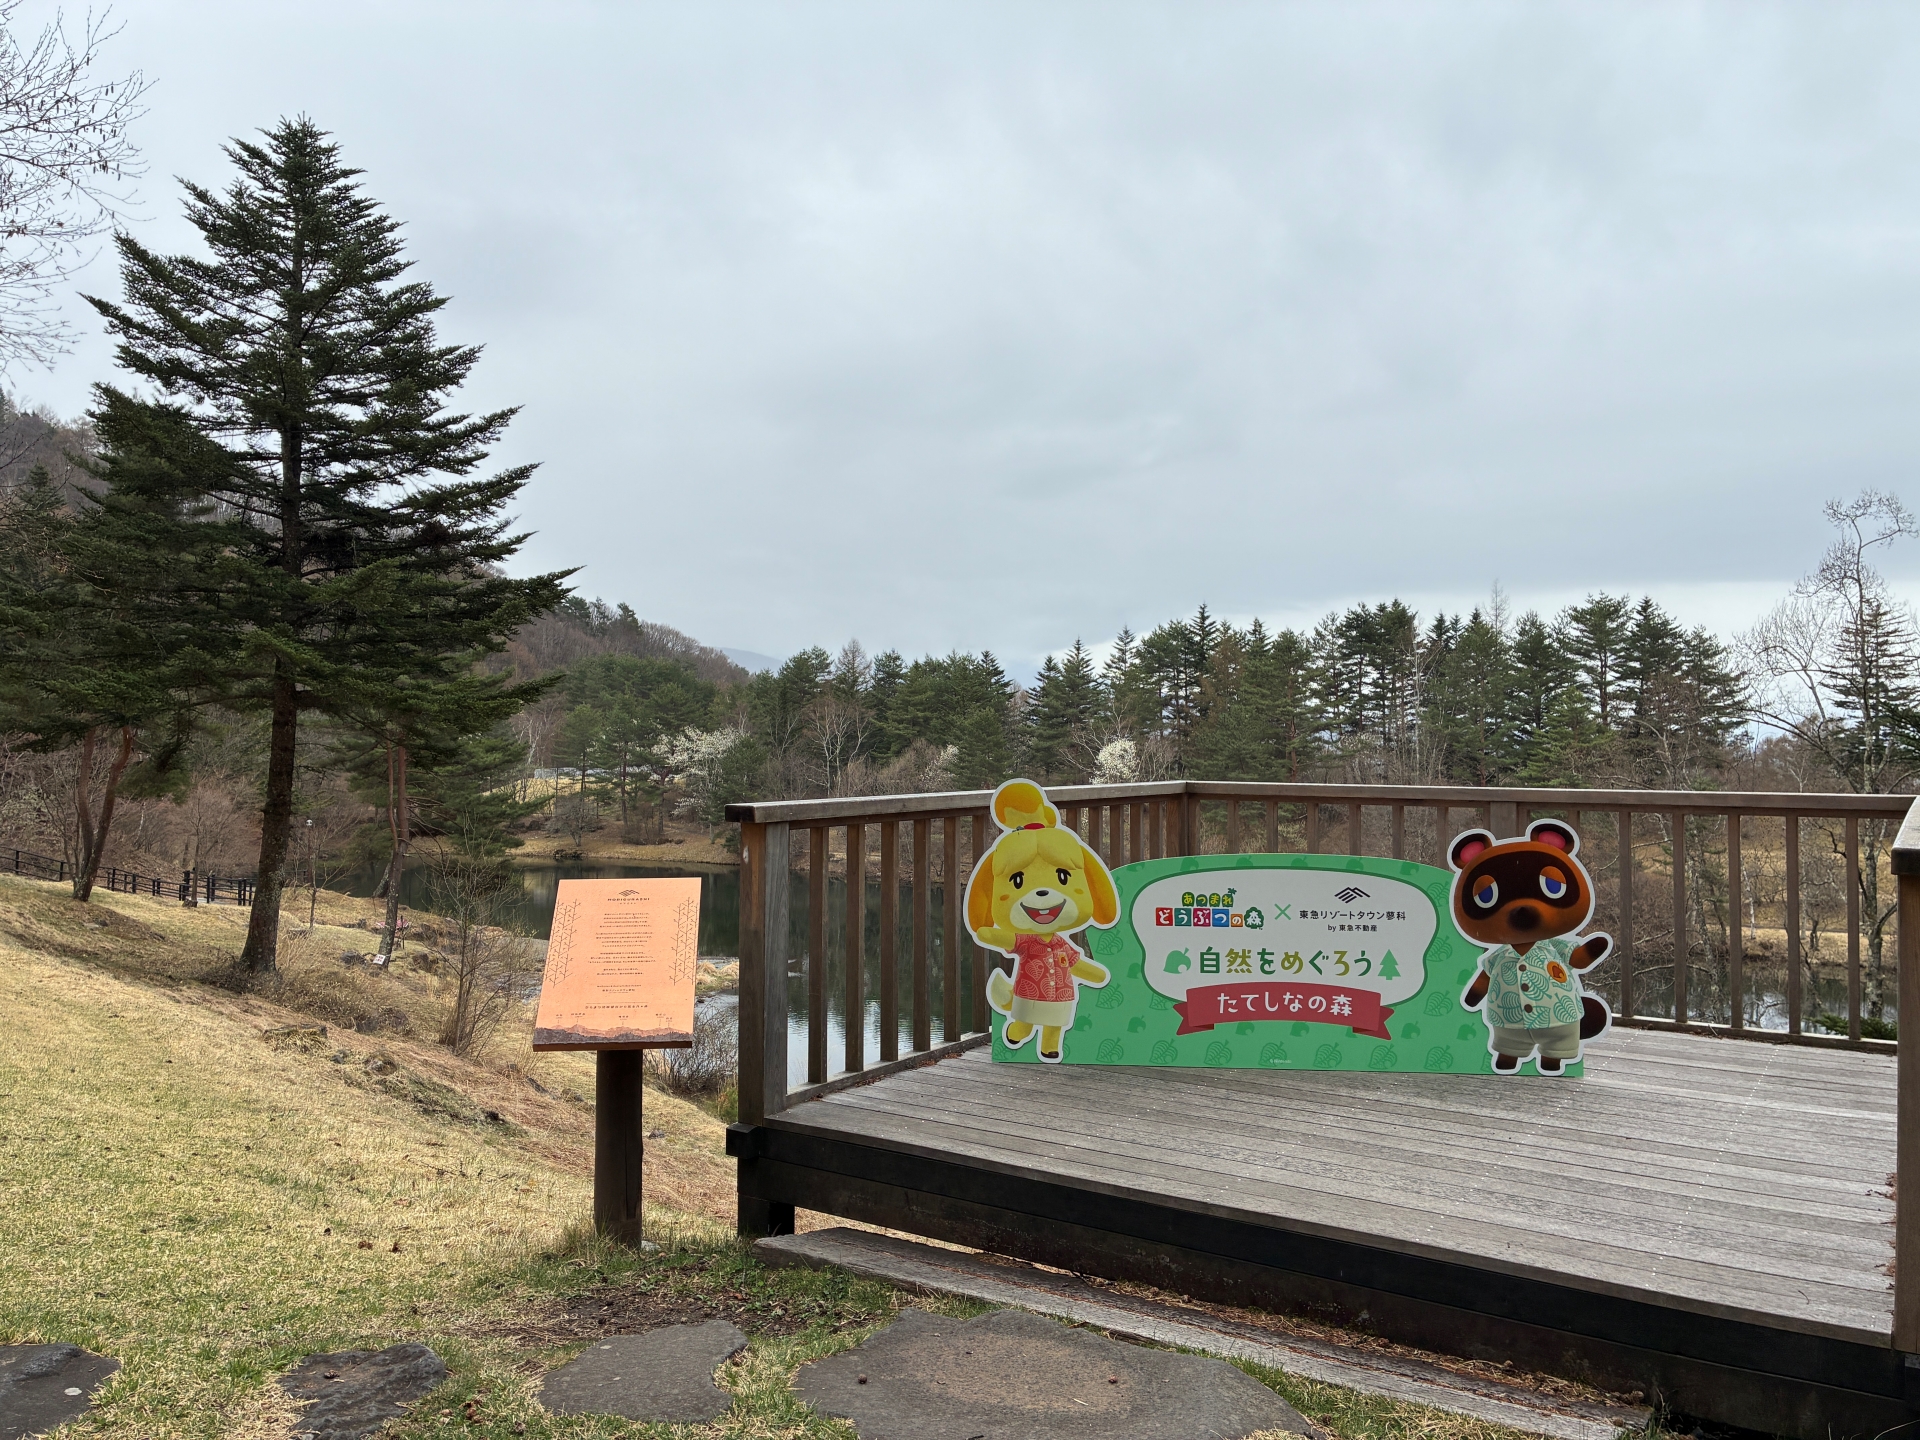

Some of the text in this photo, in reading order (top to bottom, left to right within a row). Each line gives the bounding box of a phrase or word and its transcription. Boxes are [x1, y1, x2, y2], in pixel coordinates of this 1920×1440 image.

[1183, 893, 1233, 905] あつまれ
[1157, 909, 1263, 926] どうぶつの森
[1299, 909, 1406, 921] 東急リゾートタウン蓼科
[1327, 924, 1378, 932] by 東急不動産
[1199, 945, 1372, 977] 自然をめぐろう
[1217, 991, 1353, 1017] たてしなの森
